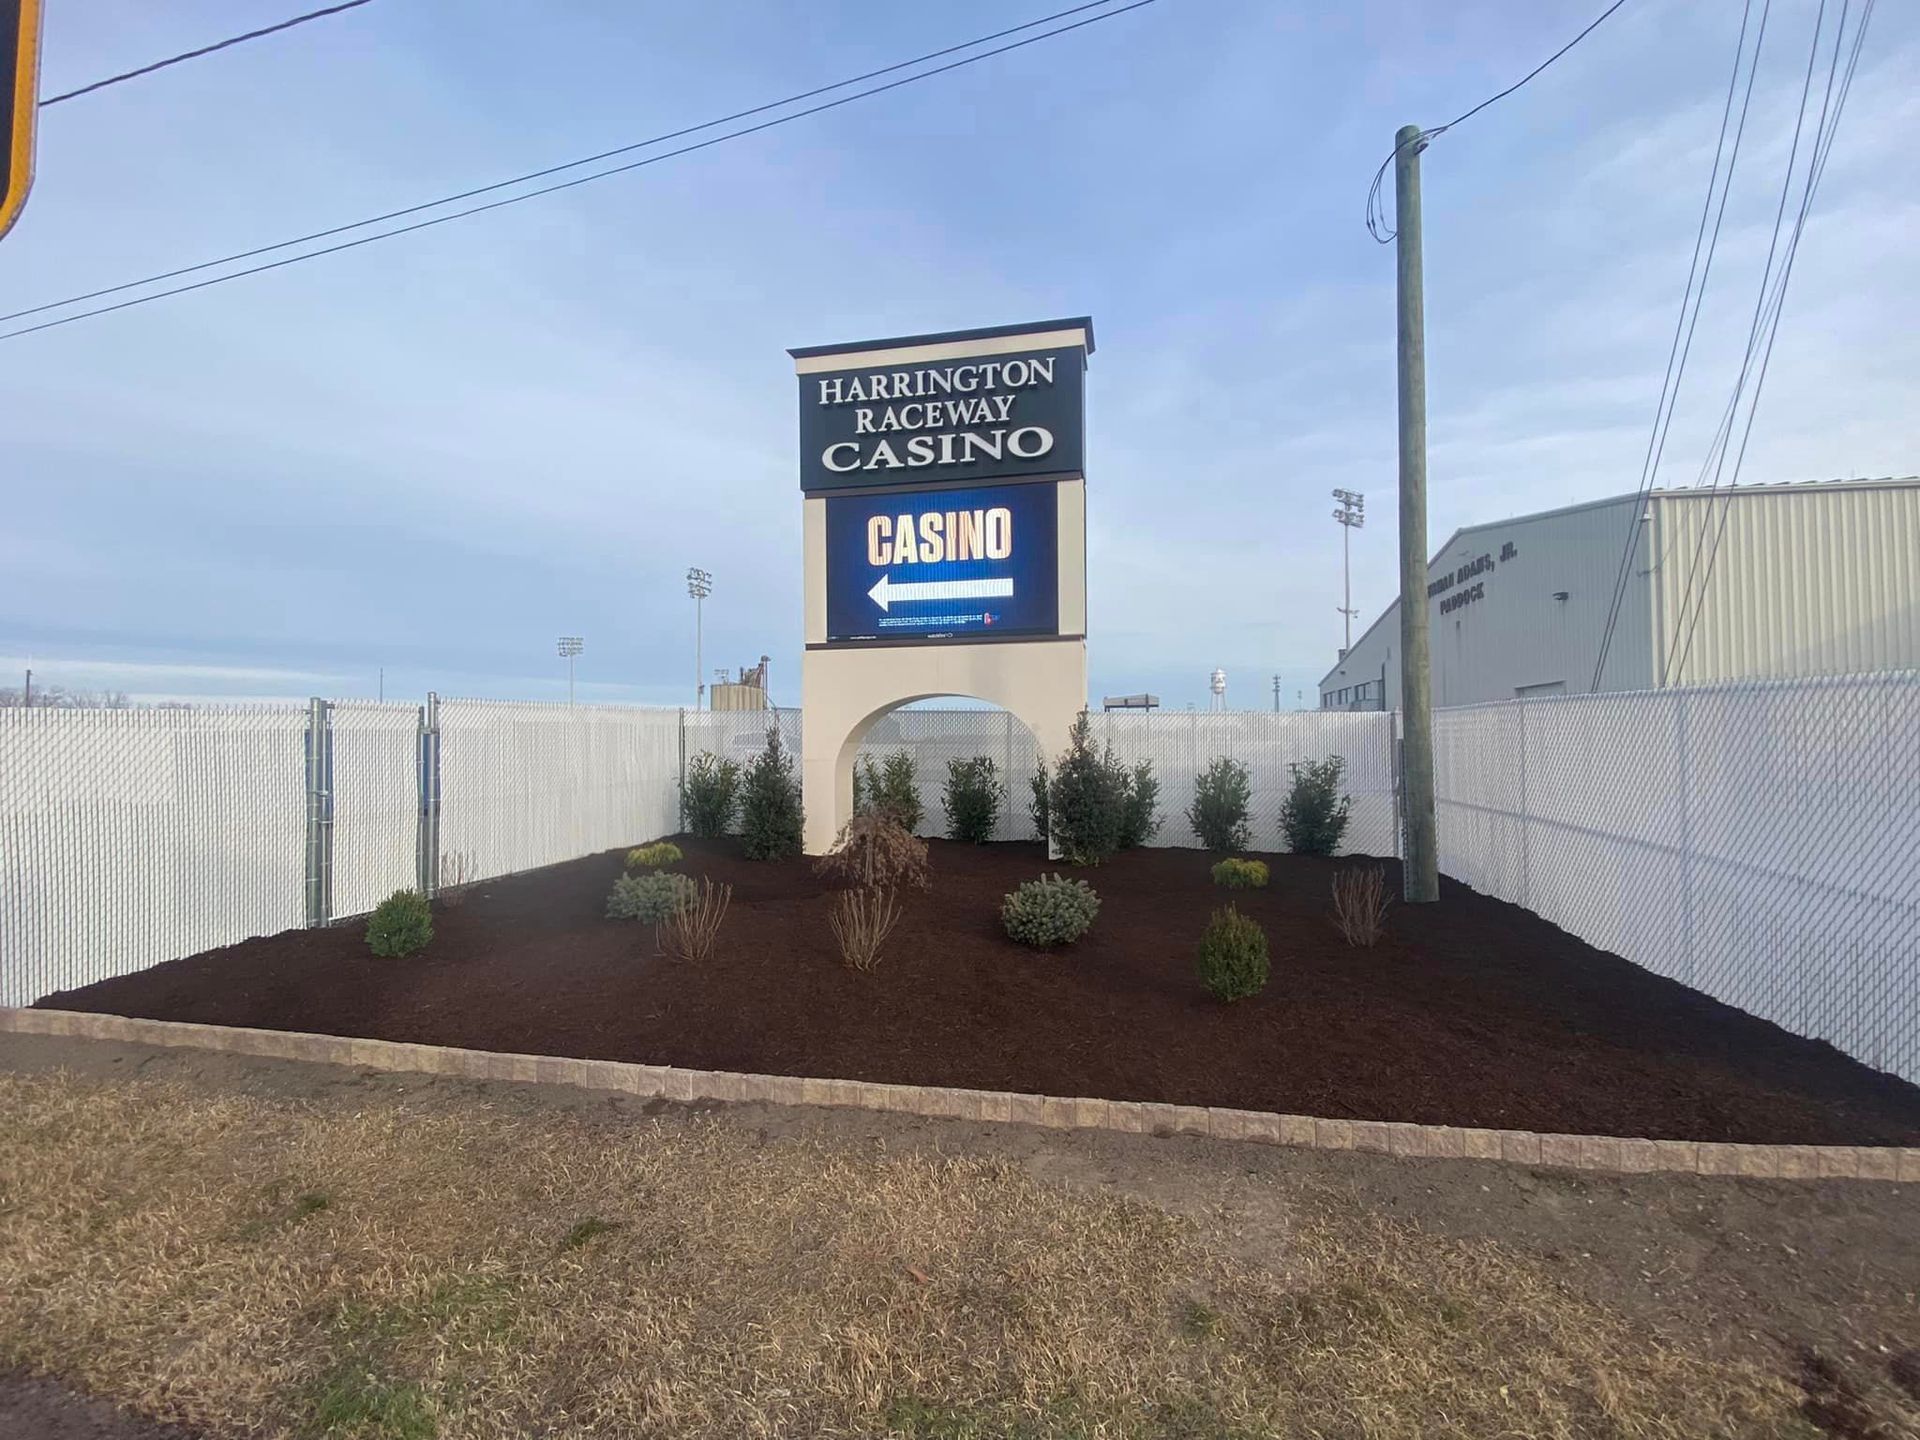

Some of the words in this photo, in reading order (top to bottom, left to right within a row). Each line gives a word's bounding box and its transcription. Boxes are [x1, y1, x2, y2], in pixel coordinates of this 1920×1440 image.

[819, 357, 1055, 404] HARRINGTON
[855, 395, 1016, 433] RACEWAY
[822, 427, 1054, 472] CASINO
[868, 508, 1012, 566] CASINO
[1440, 582, 1484, 615] PADDOCK
